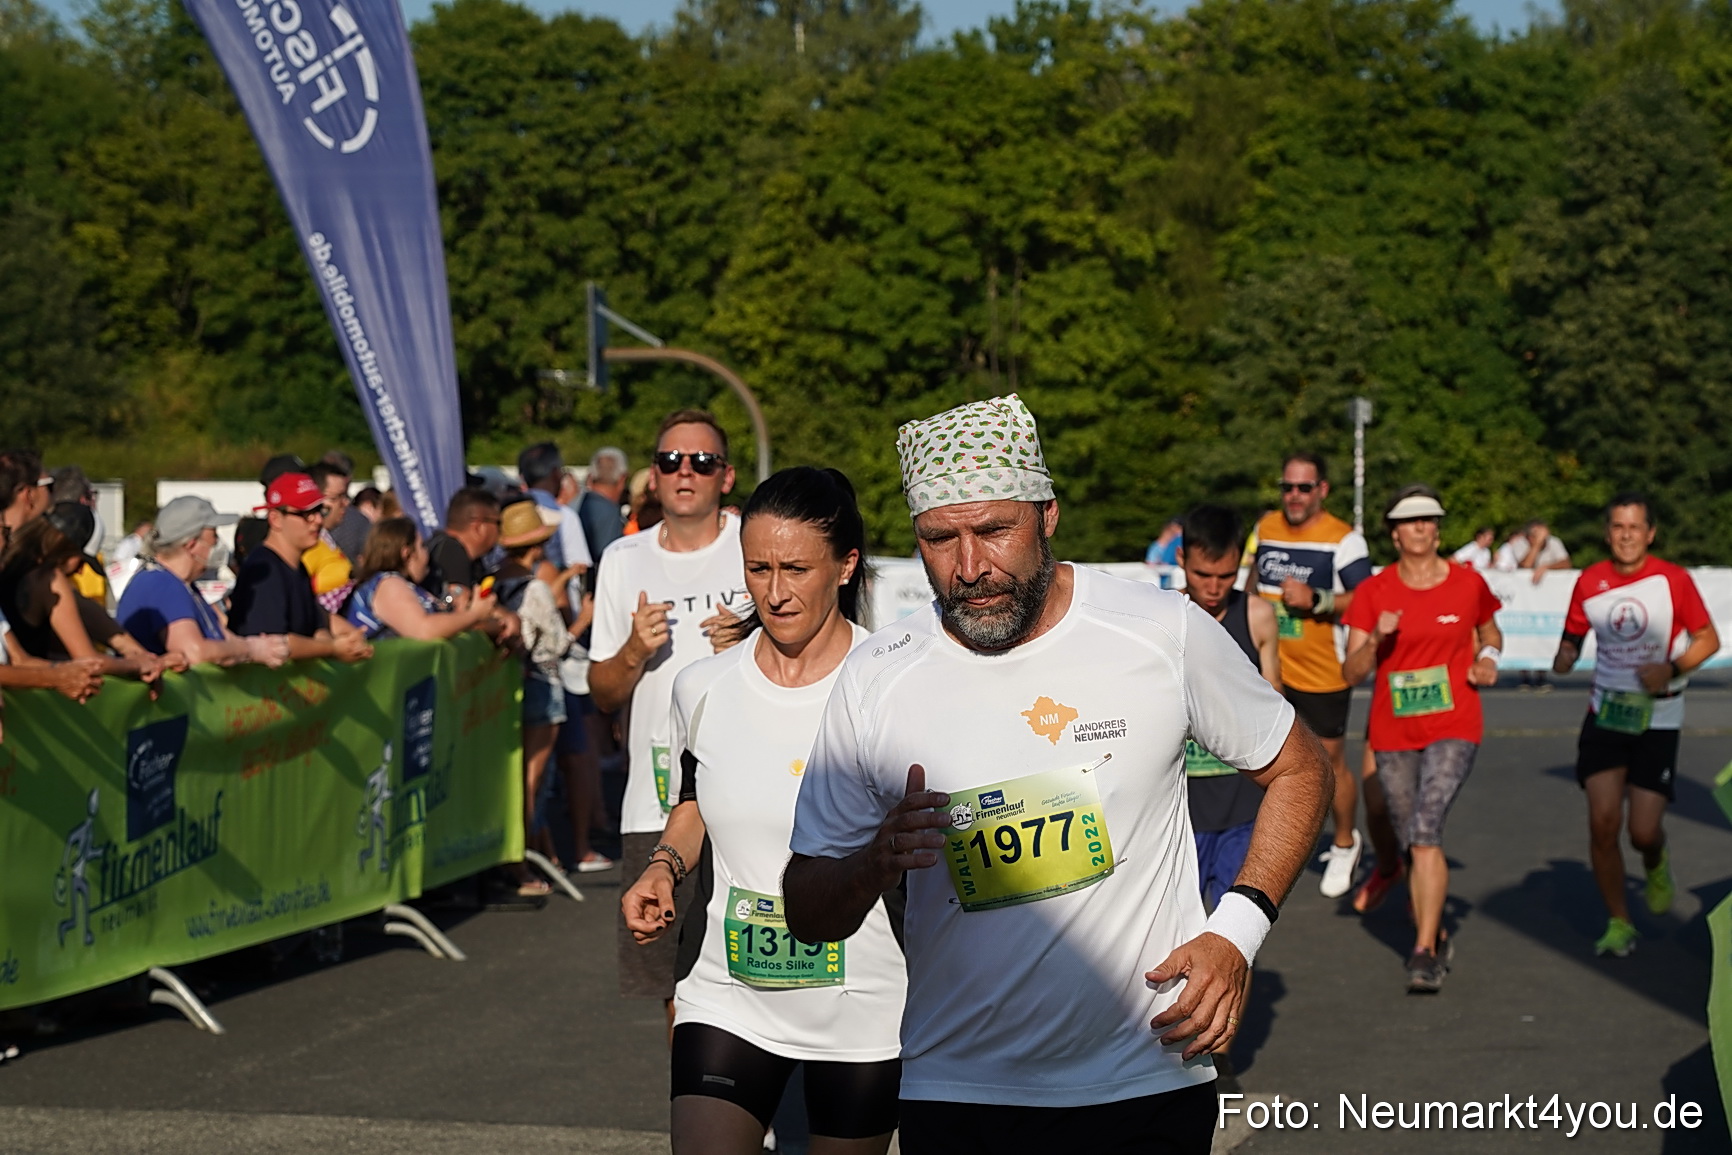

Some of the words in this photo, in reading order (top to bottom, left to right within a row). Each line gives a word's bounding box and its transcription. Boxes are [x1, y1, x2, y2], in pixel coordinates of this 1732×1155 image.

[888, 633, 911, 652] JAKO
[1040, 713, 1059, 726] NM
[1073, 719, 1127, 733] LANDKREIS
[1074, 729, 1127, 742] NEUMARKT
[976, 799, 1025, 821] Firmenlauf
[996, 807, 1026, 821] neumarkt
[101, 789, 223, 905] firmenlauf
[969, 811, 1075, 869] 1977
[1081, 812, 1106, 867] 2022
[951, 839, 977, 897] WALK
[751, 910, 785, 919] Firmenlau
[729, 930, 739, 962] RUN
[746, 956, 782, 970] Rados
[786, 960, 815, 971] Silke
[826, 941, 839, 973] 202
